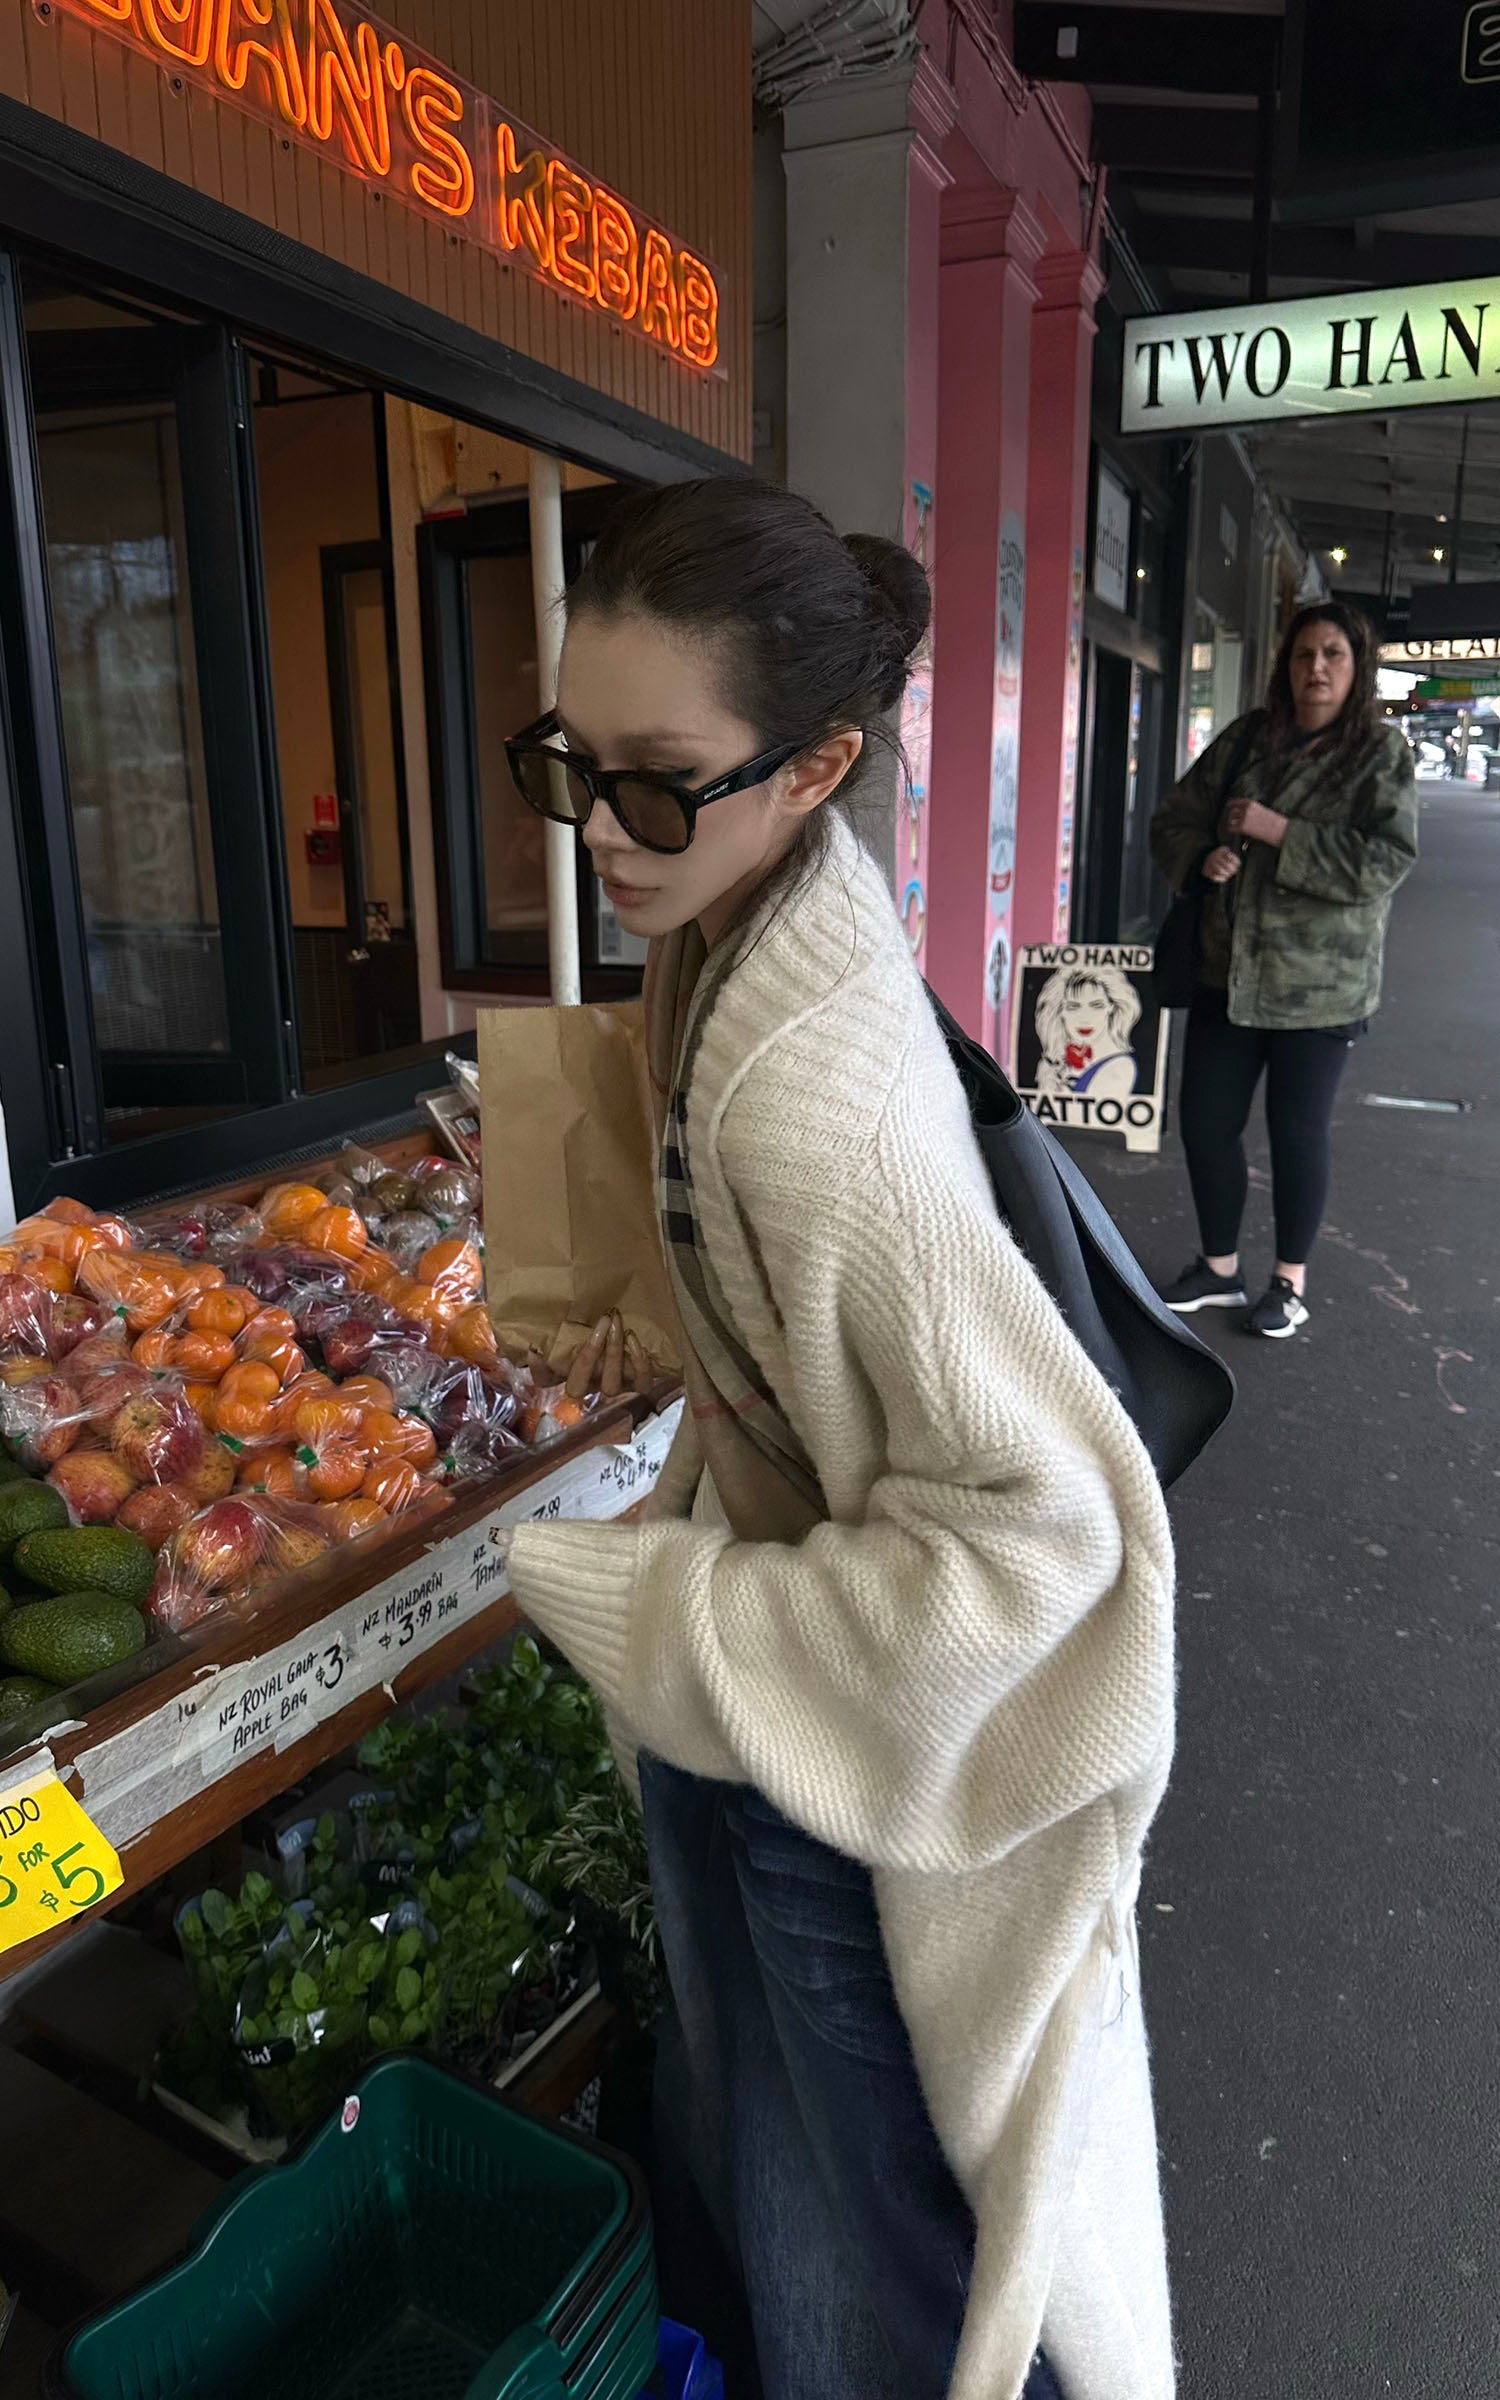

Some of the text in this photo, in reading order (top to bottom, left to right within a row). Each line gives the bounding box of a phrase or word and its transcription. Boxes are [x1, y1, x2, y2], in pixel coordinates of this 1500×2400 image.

[80, 0, 719, 367] AN'S KEBAB
[1135, 303, 1500, 410] TWO HAN
[1024, 947, 1151, 967] TWO HAND
[1019, 1094, 1154, 1127] TATTOO
[473, 1544, 486, 1565] NZ
[438, 1592, 458, 1619] BAG
[362, 1609, 380, 1636] NZ
[219, 1652, 319, 1732] NZ ROYAL GALA
[233, 1688, 308, 1754] APPLE BAG
[17, 1841, 51, 1873] FOR
